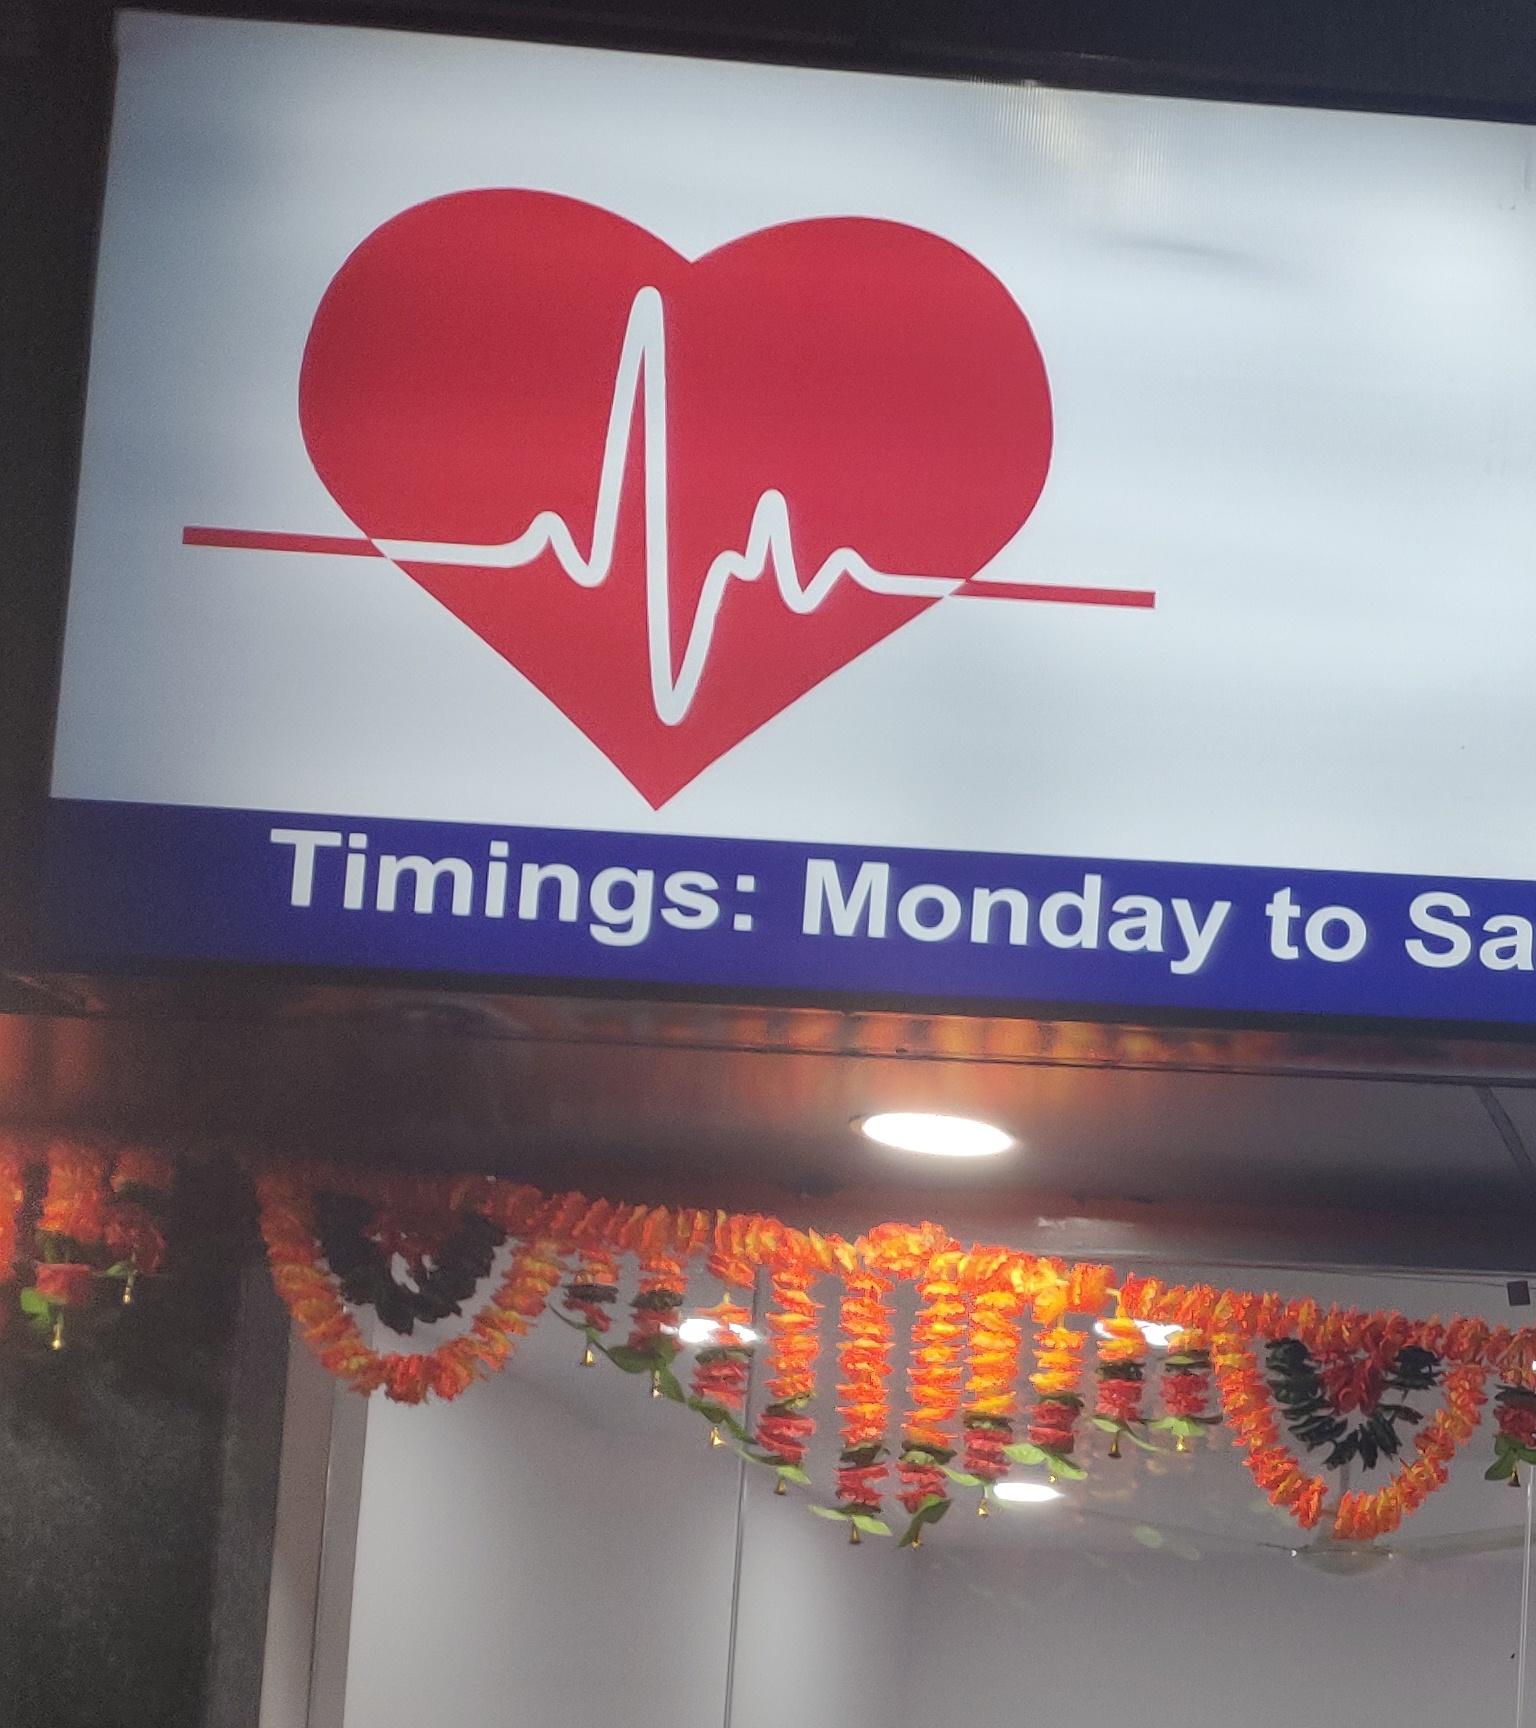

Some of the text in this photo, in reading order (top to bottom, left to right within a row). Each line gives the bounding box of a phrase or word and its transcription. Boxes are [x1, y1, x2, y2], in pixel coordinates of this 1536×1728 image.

[269, 828, 756, 948] Timings:
[801, 857, 1233, 976] Monday
[1264, 885, 1368, 964] to
